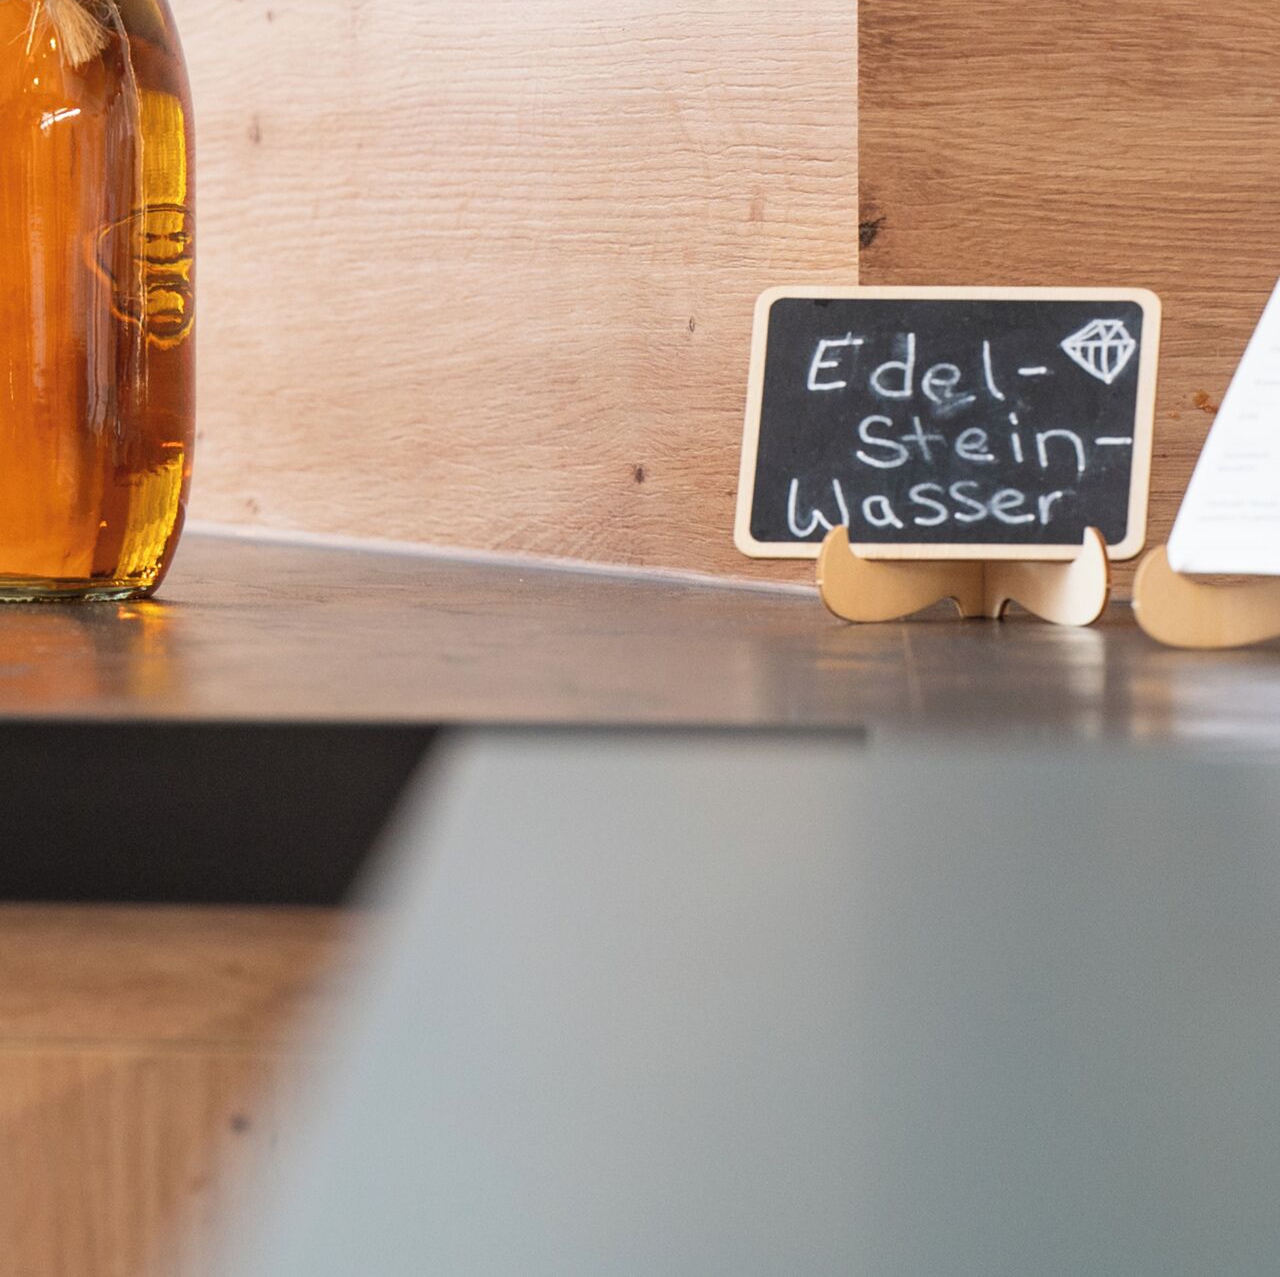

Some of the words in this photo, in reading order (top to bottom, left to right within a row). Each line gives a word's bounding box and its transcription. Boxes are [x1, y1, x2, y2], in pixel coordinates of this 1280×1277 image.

[807, 332, 1047, 402] Edel-
[856, 412, 1133, 472] Stein-
[787, 478, 1064, 538] Wasser
